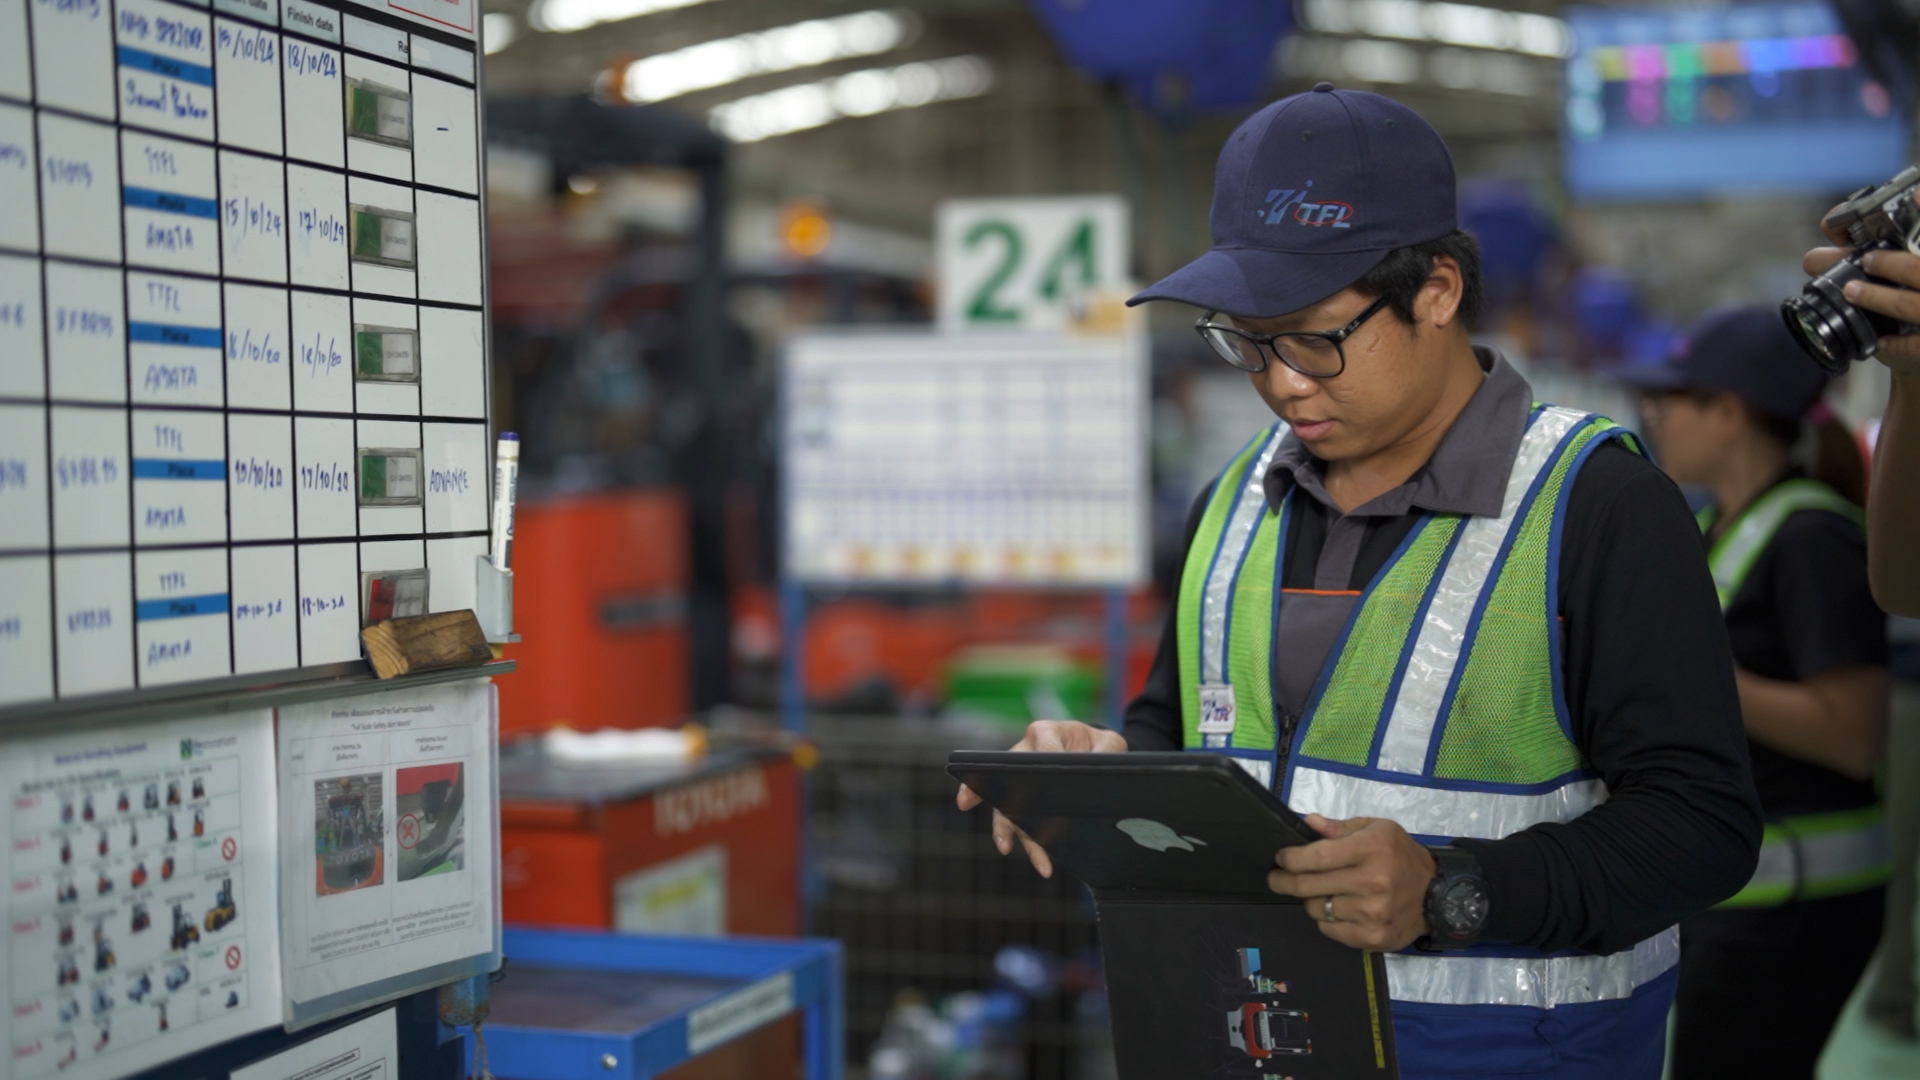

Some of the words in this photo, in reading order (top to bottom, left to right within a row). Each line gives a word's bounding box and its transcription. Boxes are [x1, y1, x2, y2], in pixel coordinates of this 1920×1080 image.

[288, 6, 314, 26] Finish
[316, 17, 334, 32] date
[961, 215, 1099, 323] 24
